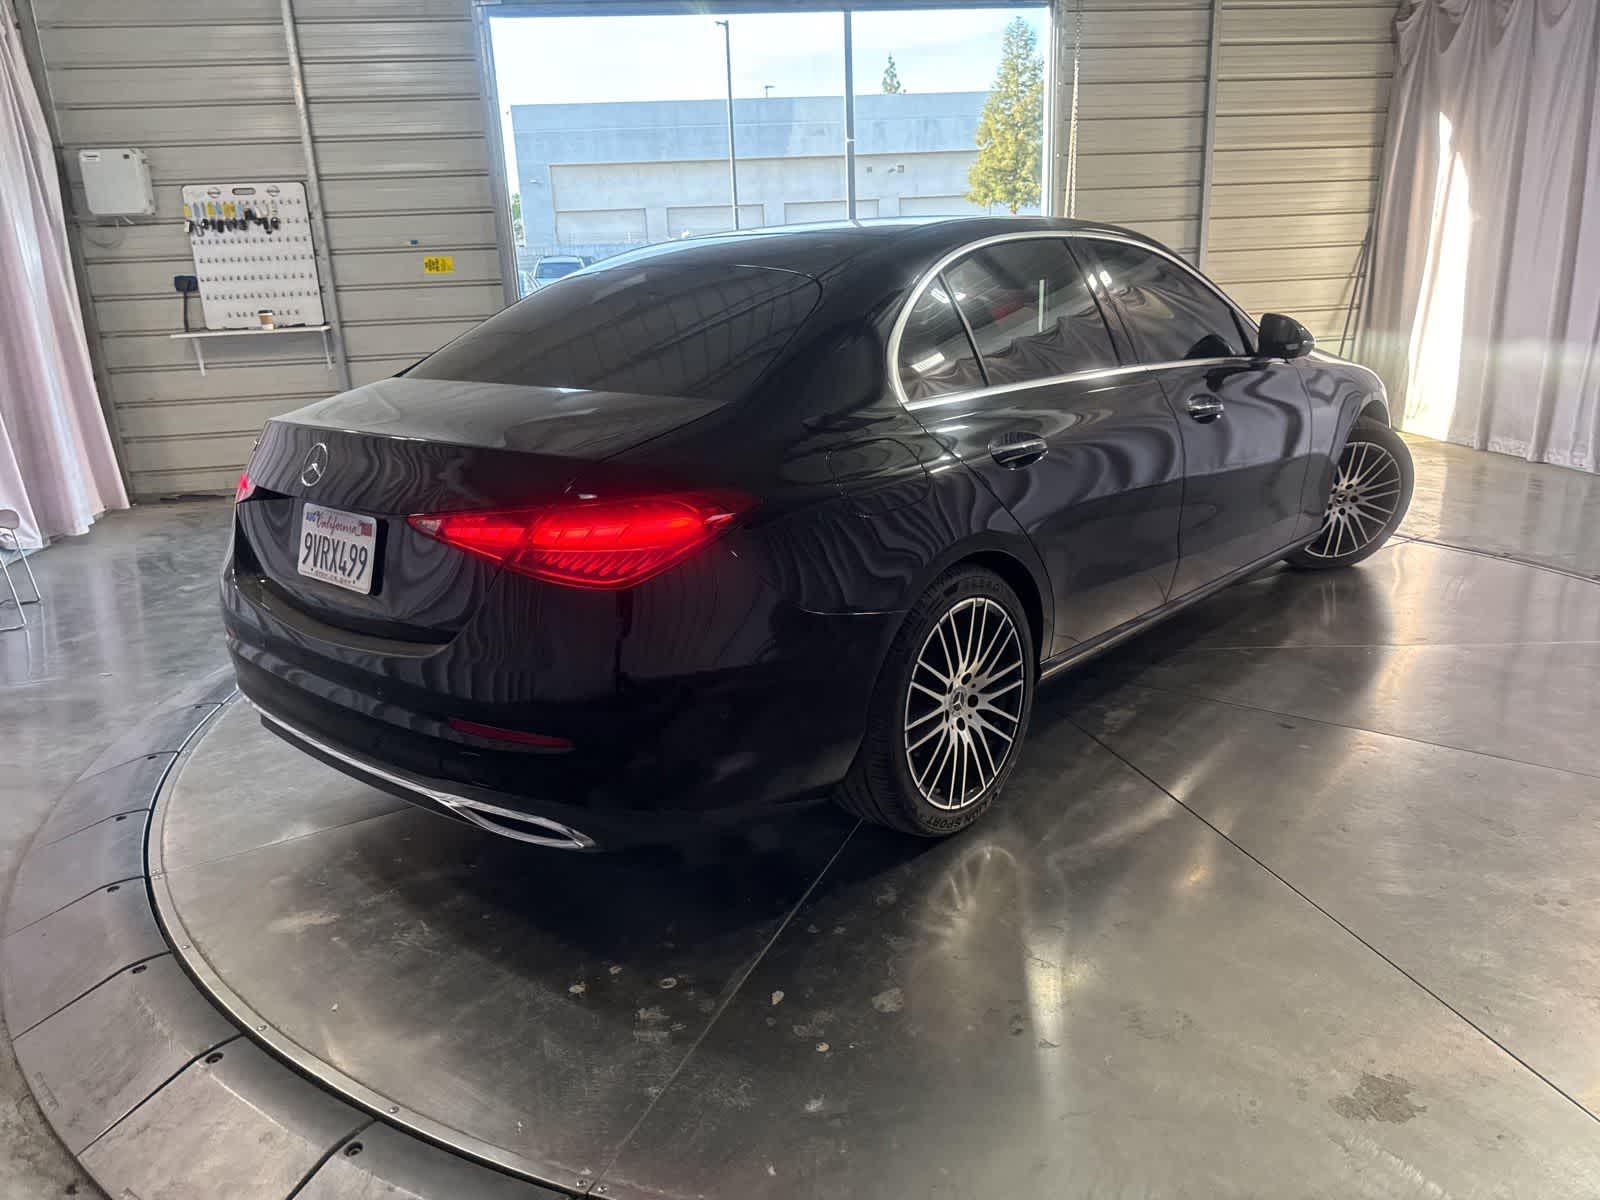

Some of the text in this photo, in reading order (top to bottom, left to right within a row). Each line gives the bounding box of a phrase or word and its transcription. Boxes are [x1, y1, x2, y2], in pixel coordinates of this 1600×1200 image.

[315, 511, 355, 535] California
[302, 532, 368, 580] 9VRX499
[927, 816, 961, 829] SPORT
